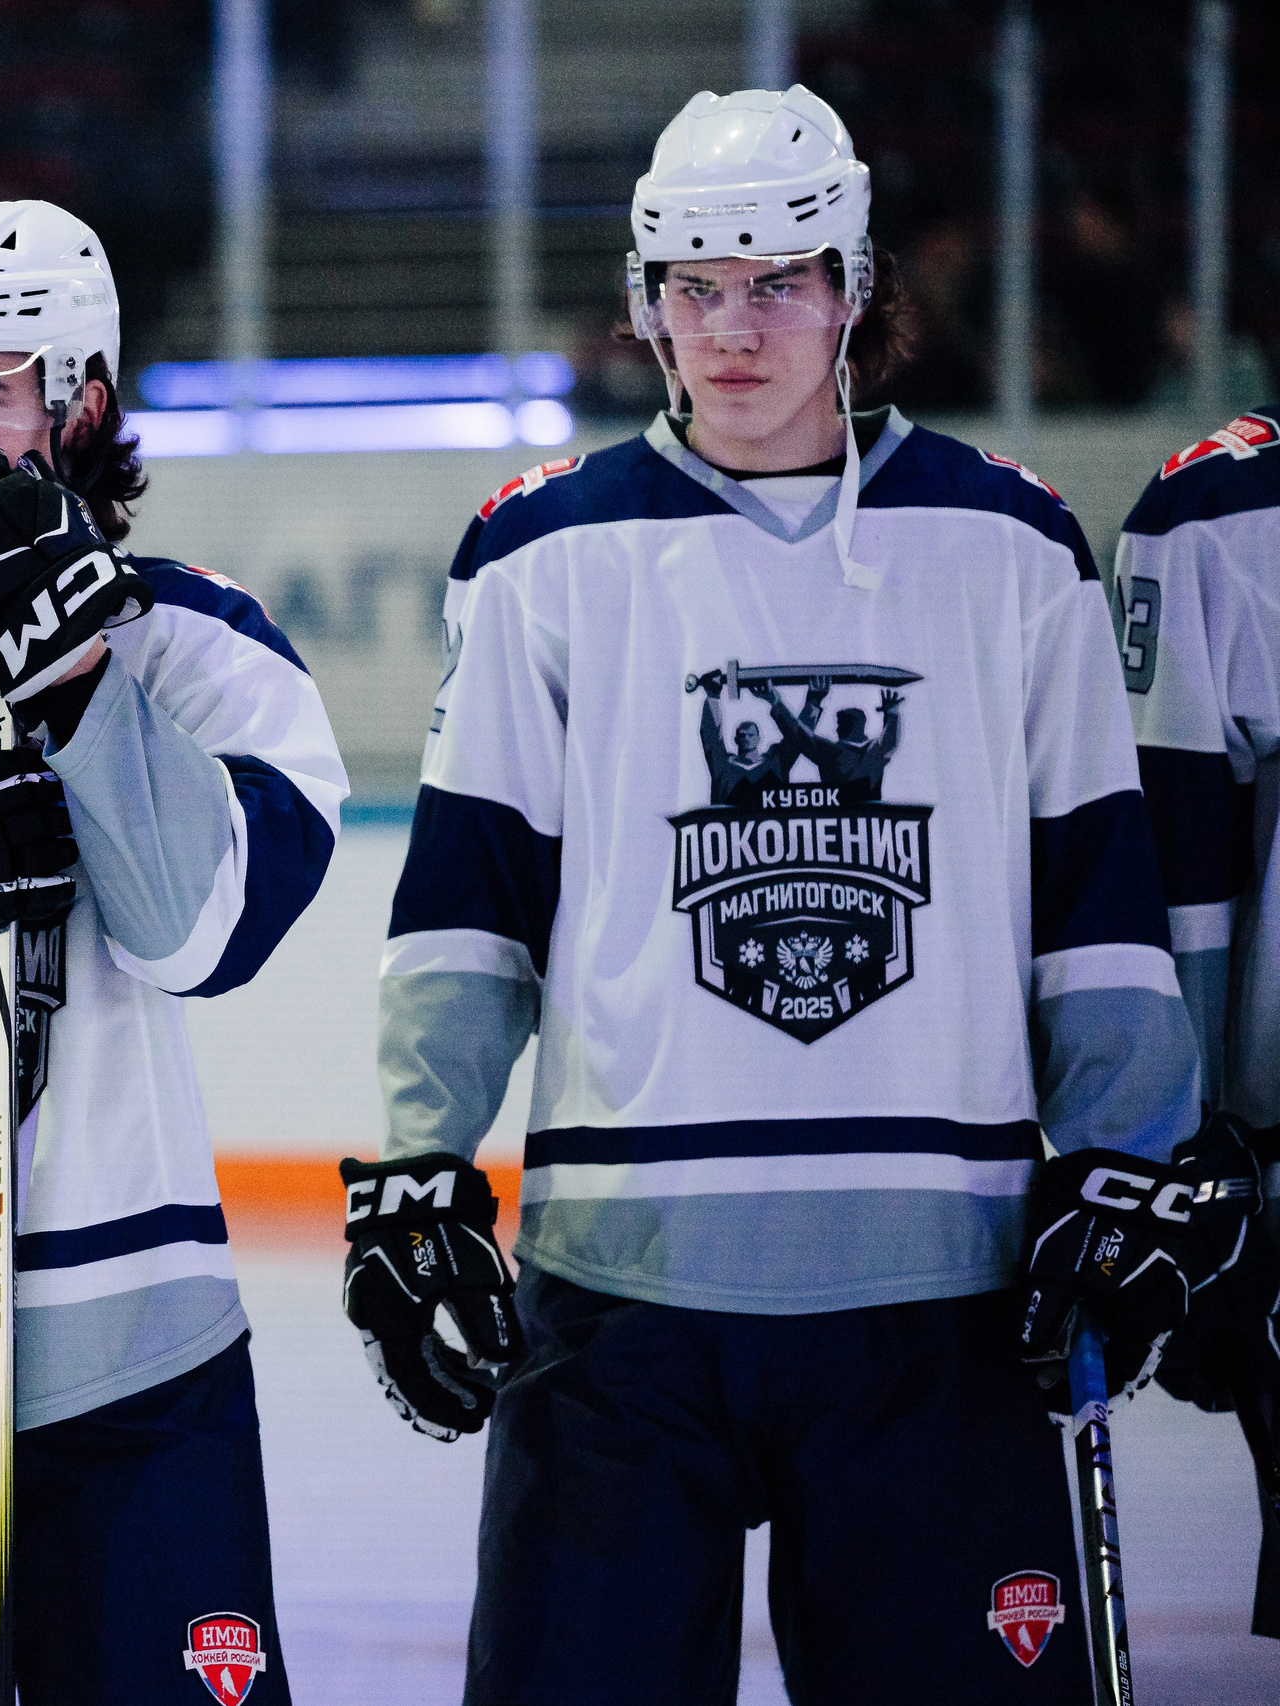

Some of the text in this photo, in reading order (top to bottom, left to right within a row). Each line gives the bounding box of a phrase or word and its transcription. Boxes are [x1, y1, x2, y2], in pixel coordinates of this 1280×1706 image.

[1116, 575, 1162, 695] 3
[762, 787, 841, 809] КУБОК
[679, 817, 922, 889] ПОКОЛЕНИЯ
[720, 882, 886, 924] МАГНИТОГОРСК
[780, 995, 834, 1021] 2025
[346, 1171, 457, 1224] CM
[1080, 1167, 1195, 1224] CC
[1003, 1583, 1049, 1607] НМХЛ
[202, 1626, 251, 1648] НМХЛ
[191, 1651, 261, 1665] ХОККЕЙ РОССИИ
